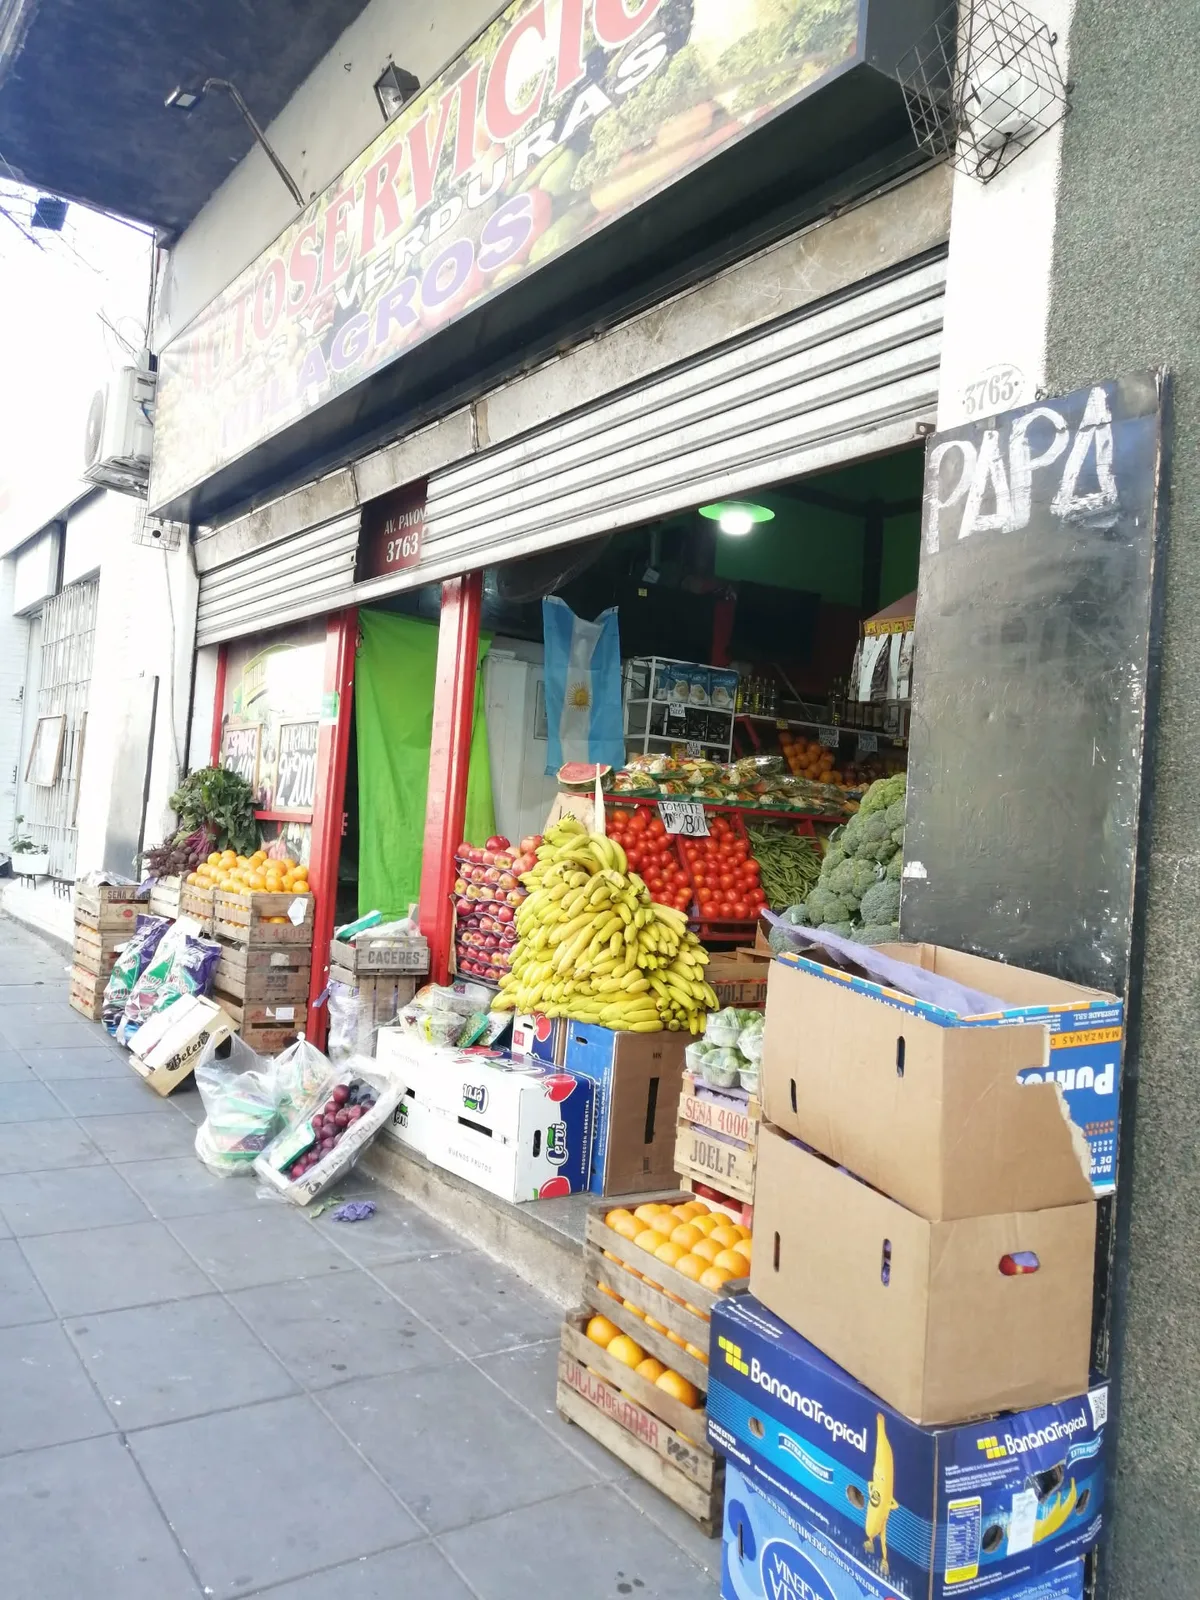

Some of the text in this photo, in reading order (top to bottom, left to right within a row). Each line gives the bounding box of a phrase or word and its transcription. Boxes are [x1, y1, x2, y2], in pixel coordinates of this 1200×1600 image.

[334, 31, 668, 311] VERDURAS
[964, 371, 1015, 416] 3763
[923, 387, 1118, 554] PAPA
[384, 518, 397, 535] AV.
[386, 532, 420, 562] 3763
[659, 802, 703, 815] TOMATE
[367, 951, 420, 966] CACERES
[1062, 1030, 1120, 1045] MANZANAS
[718, 1110, 748, 1139] 4000
[546, 1121, 568, 1166] Cervi
[689, 1139, 723, 1174] JOEL
[751, 1357, 867, 1453] BananaTropical
[1004, 1408, 1088, 1455] BananaTropical
